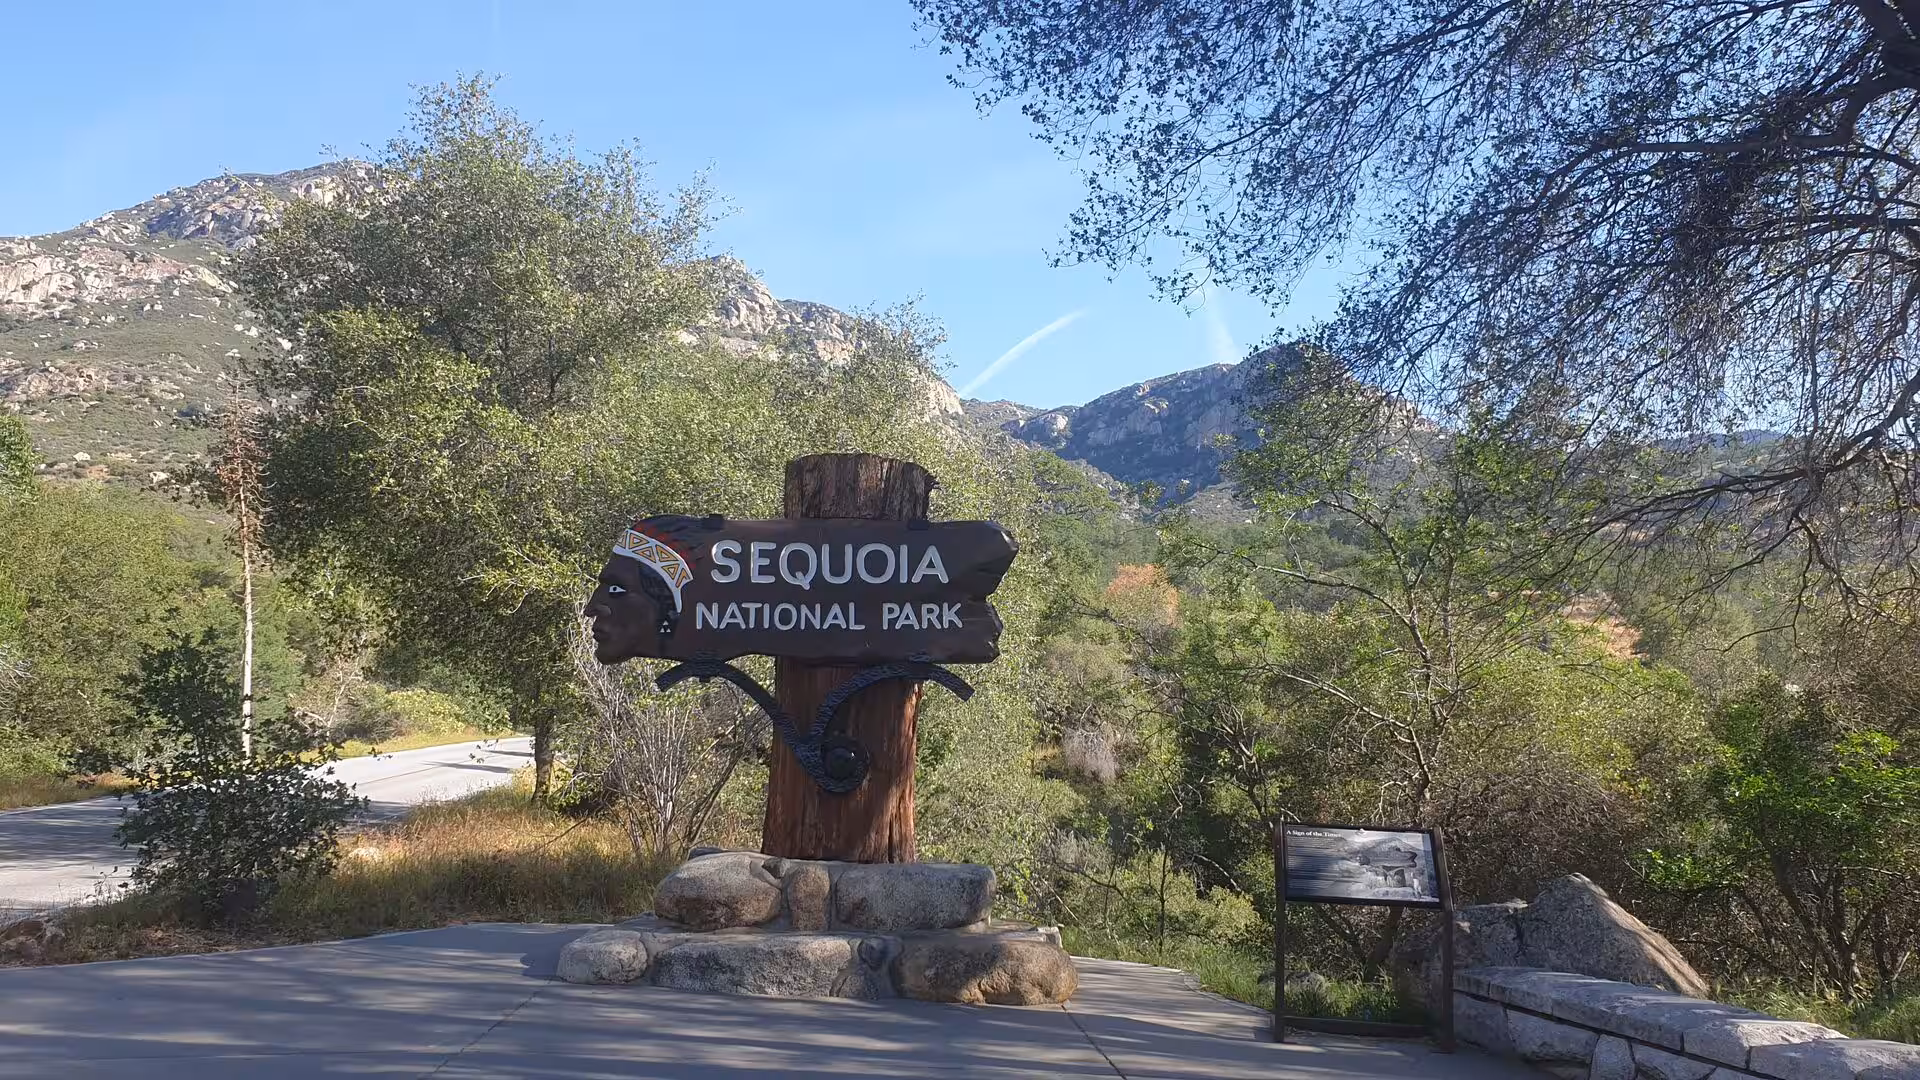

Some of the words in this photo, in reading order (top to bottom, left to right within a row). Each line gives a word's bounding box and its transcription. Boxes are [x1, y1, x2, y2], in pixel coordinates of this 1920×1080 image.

[710, 539, 949, 590] SEQUOIA
[696, 602, 865, 630] NATIONAL
[882, 602, 963, 630] PARK
